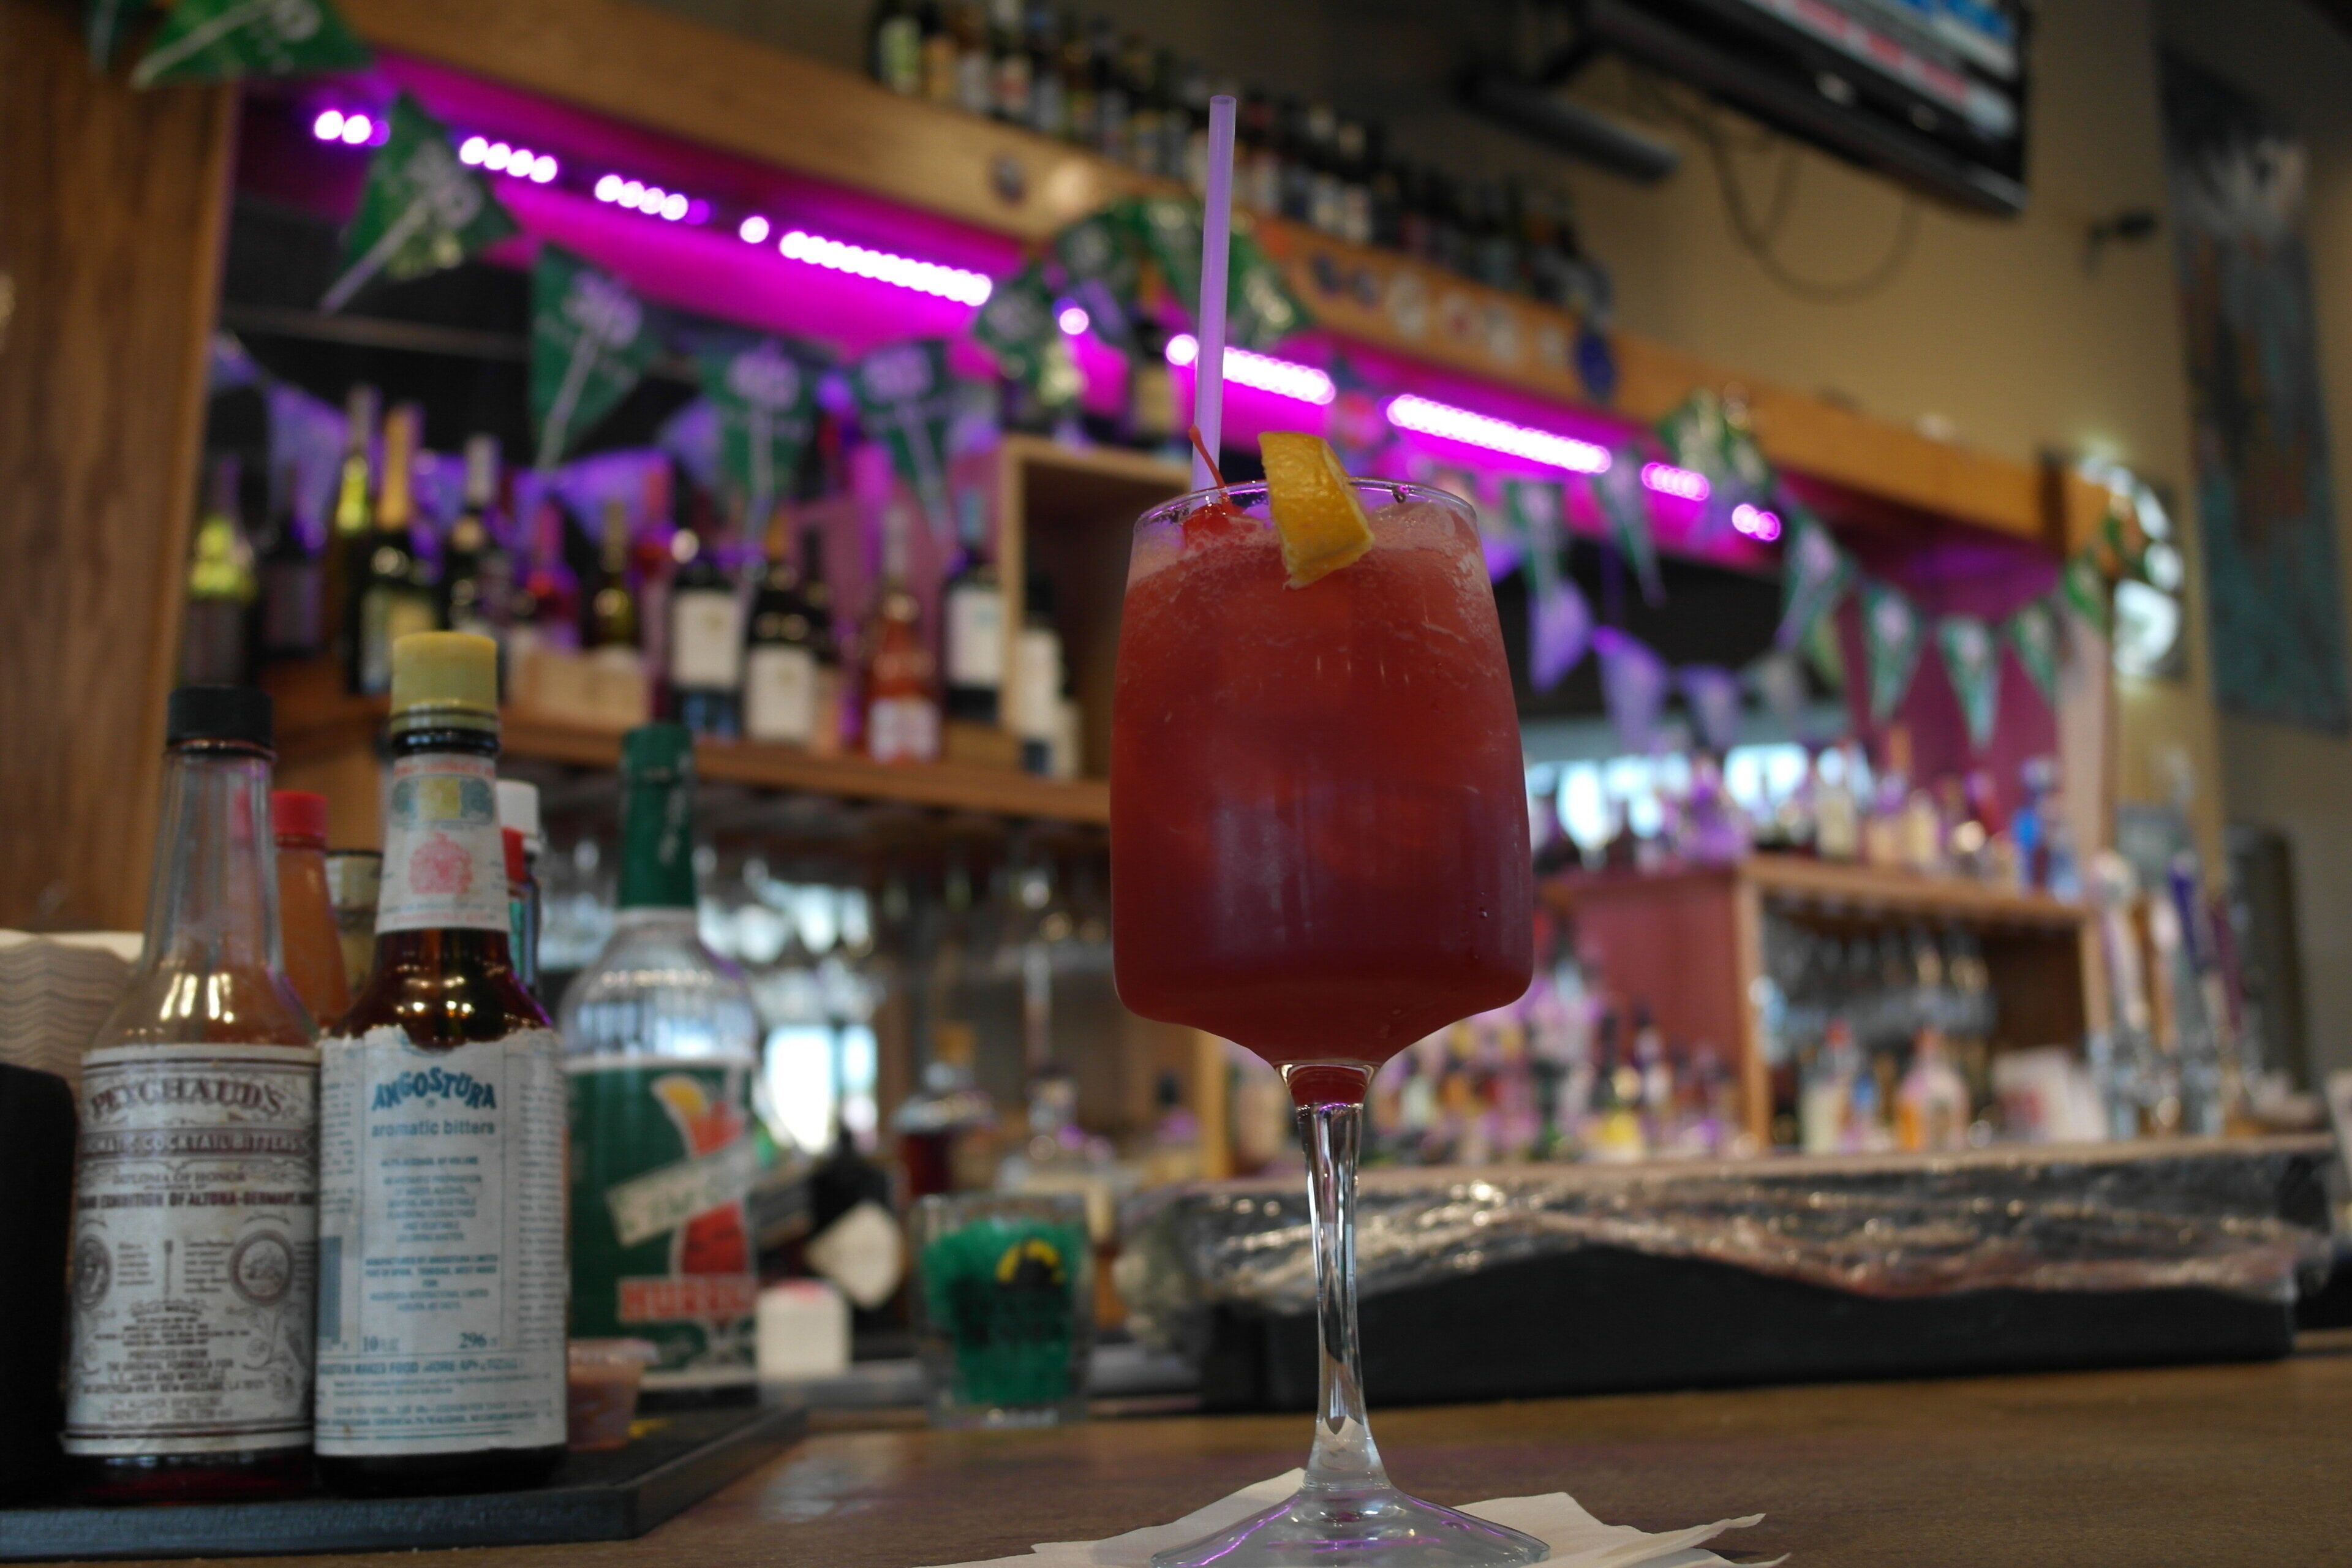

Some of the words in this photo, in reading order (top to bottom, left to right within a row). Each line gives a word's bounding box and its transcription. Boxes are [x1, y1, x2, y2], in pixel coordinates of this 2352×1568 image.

[371, 1066, 497, 1111] ANGOSTURA
[372, 1121, 439, 1137] aromatic
[443, 1120, 495, 1135] bitters
